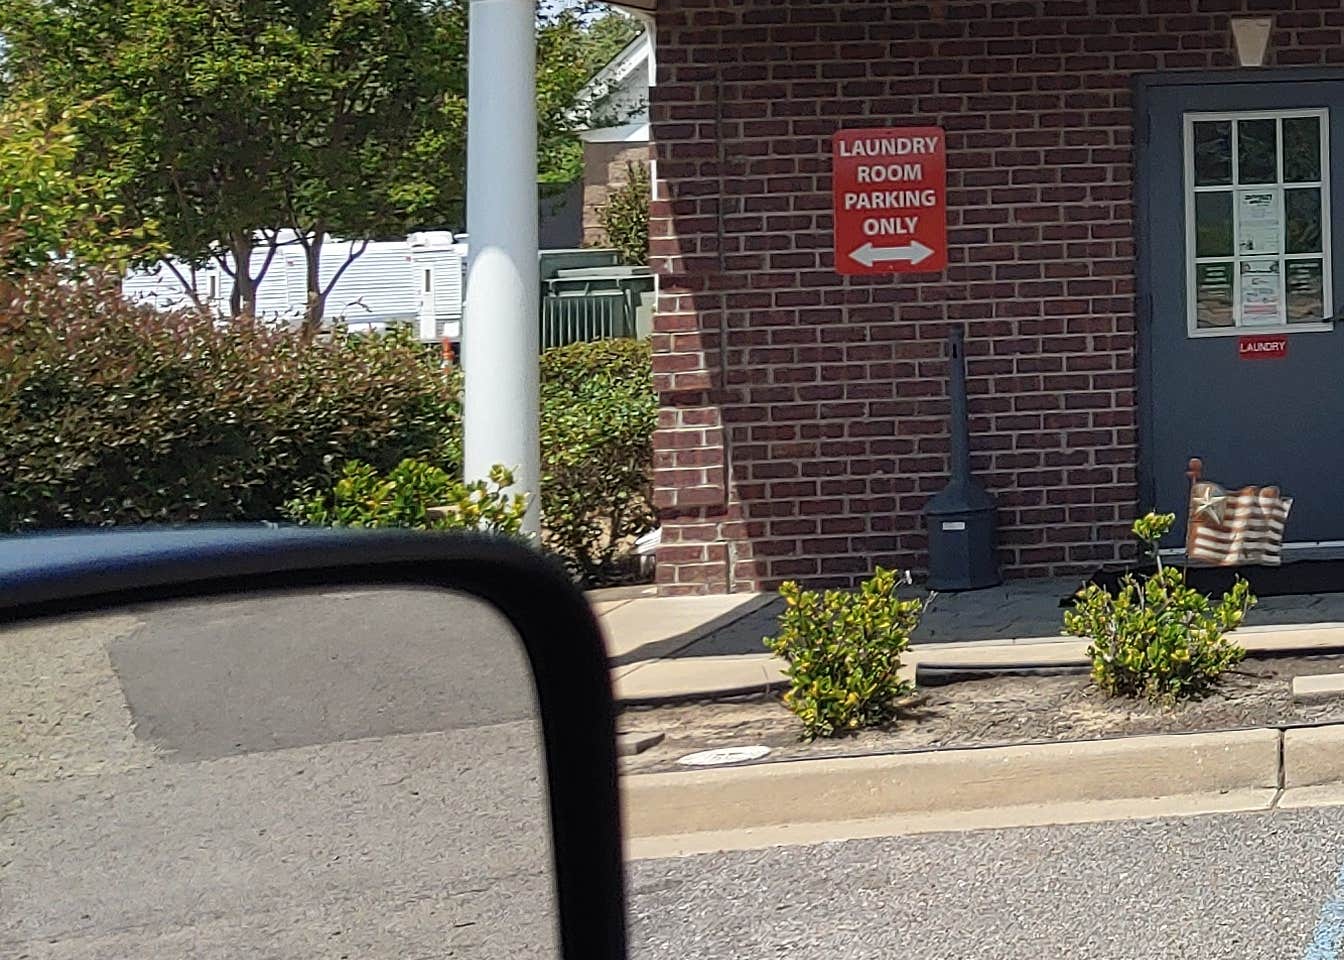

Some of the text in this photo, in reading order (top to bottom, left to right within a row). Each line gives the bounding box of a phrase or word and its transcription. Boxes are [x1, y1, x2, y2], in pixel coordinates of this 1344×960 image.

[839, 137, 938, 157] LAUNDRY
[857, 164, 922, 183] ROOM
[845, 190, 936, 210] PARKING
[863, 216, 918, 236] ONLY
[1240, 341, 1286, 352] LAUNDRY
